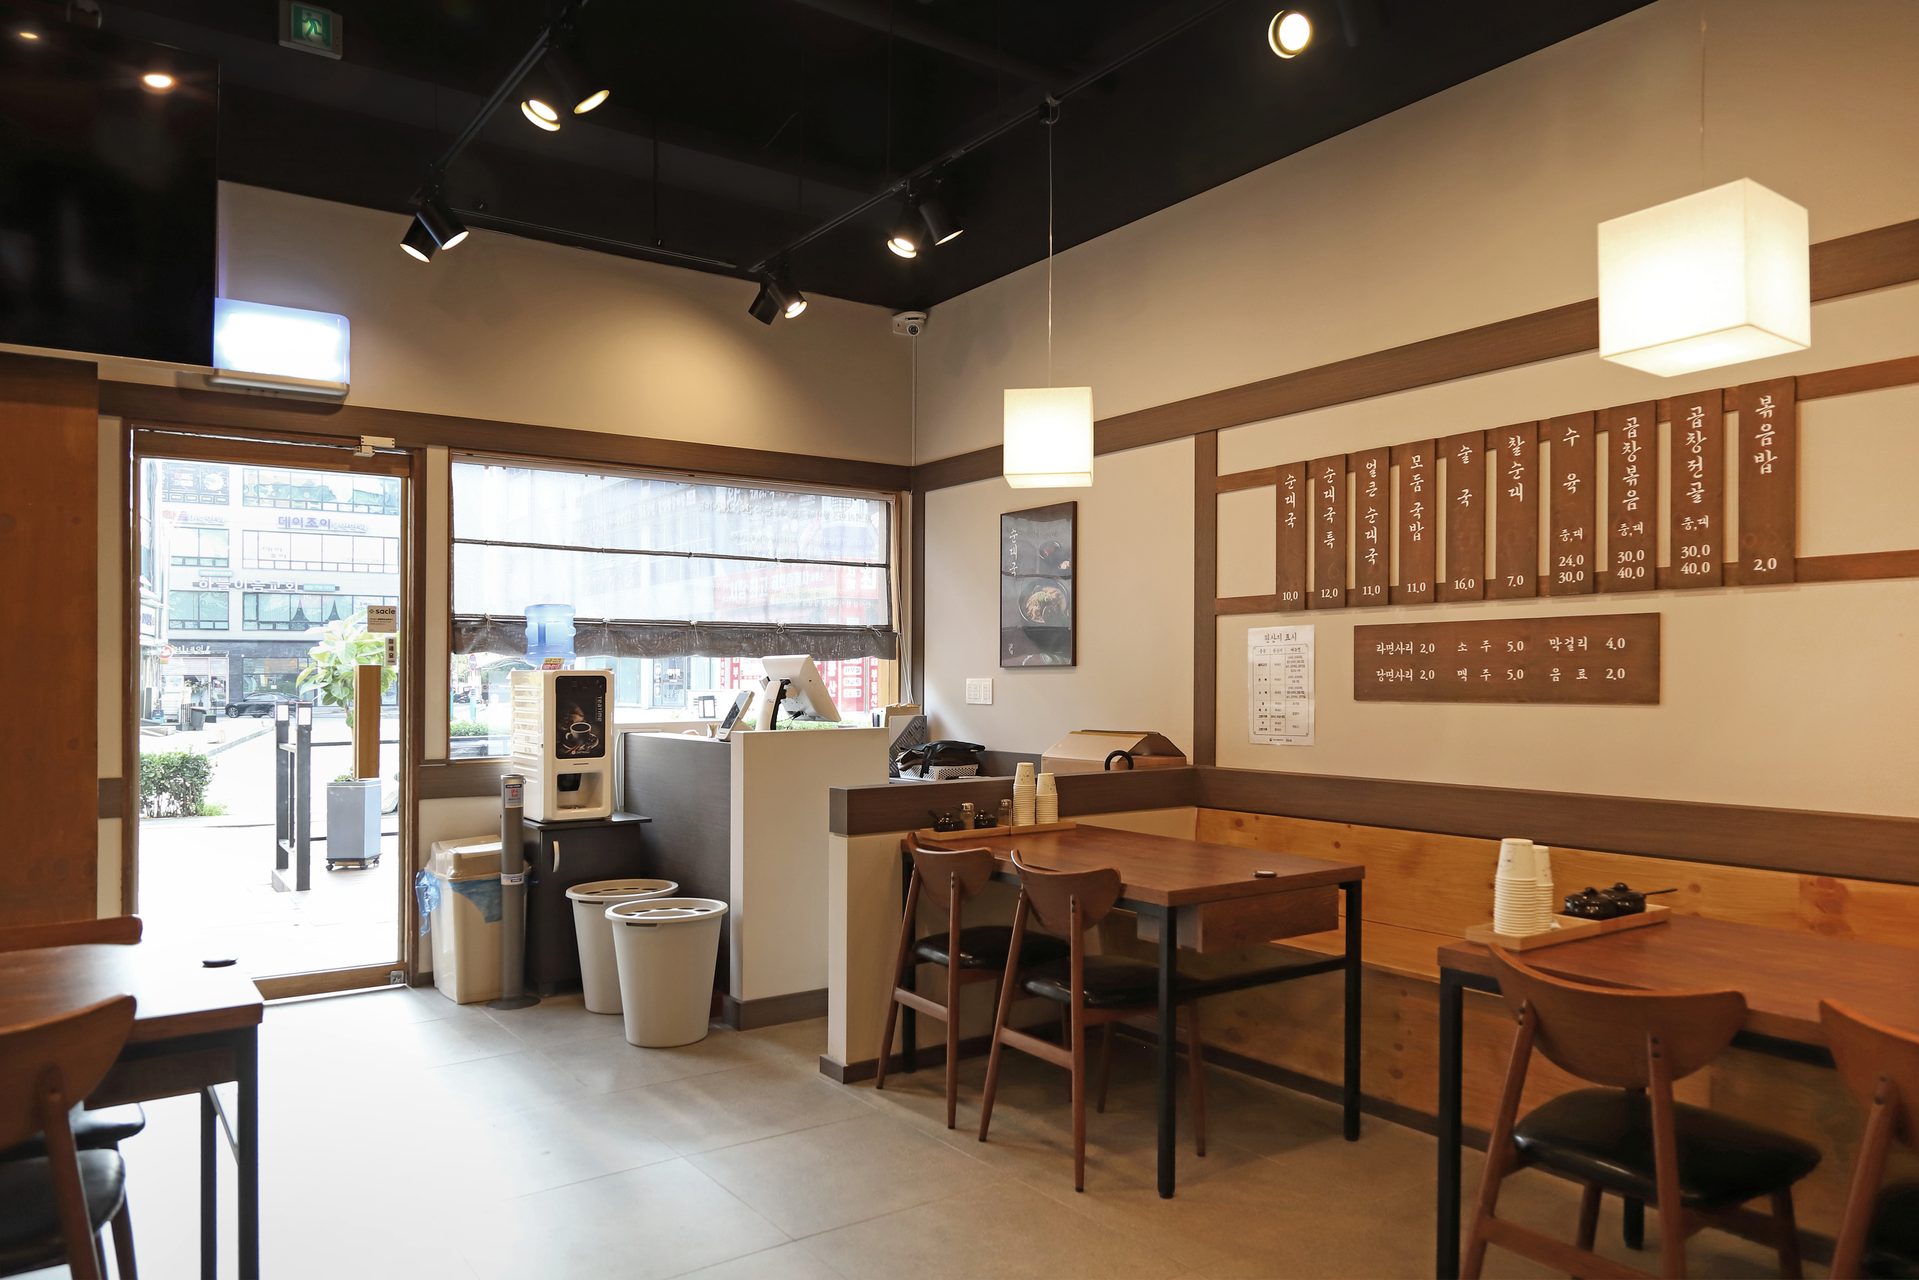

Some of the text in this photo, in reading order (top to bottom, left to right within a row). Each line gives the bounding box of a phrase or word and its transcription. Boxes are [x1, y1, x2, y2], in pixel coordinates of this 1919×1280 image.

[1753, 395, 1777, 474] 볶음밥
[1685, 406, 1707, 503] 곱창전골
[1507, 436, 1525, 501] 찰순대
[1621, 417, 1641, 510] 곱창볶음
[1284, 474, 1296, 528] 순대국
[1409, 455, 1424, 541] 모둠 국밥
[1364, 459, 1378, 565] 얼큰 순대국
[1617, 550, 1644, 563] 30.0
[1680, 545, 1710, 558] 30.0
[1558, 555, 1584, 567] 24.0
[1753, 558, 1777, 571] 2.0
[1616, 567, 1644, 579] 40.0
[1680, 562, 1710, 574] 40.0
[1506, 575, 1523, 586] 7.0
[1558, 571, 1583, 583] 30.0
[1362, 585, 1380, 595] 11.0
[1407, 582, 1425, 593] 11.0
[1454, 578, 1474, 590] 16.0
[1282, 591, 1298, 601] 10.0
[1321, 588, 1338, 598] 12.0
[1376, 642, 1413, 655] 라면사리
[1419, 643, 1435, 654] 2.0
[1507, 641, 1523, 652] 5.0
[1548, 636, 1587, 651] 막걸리
[1605, 638, 1625, 650] 4.0
[1375, 669, 1412, 681] 당면사리
[1419, 670, 1434, 680] 2.0
[1506, 669, 1523, 680] 5.0
[1605, 668, 1625, 680] 2.0
